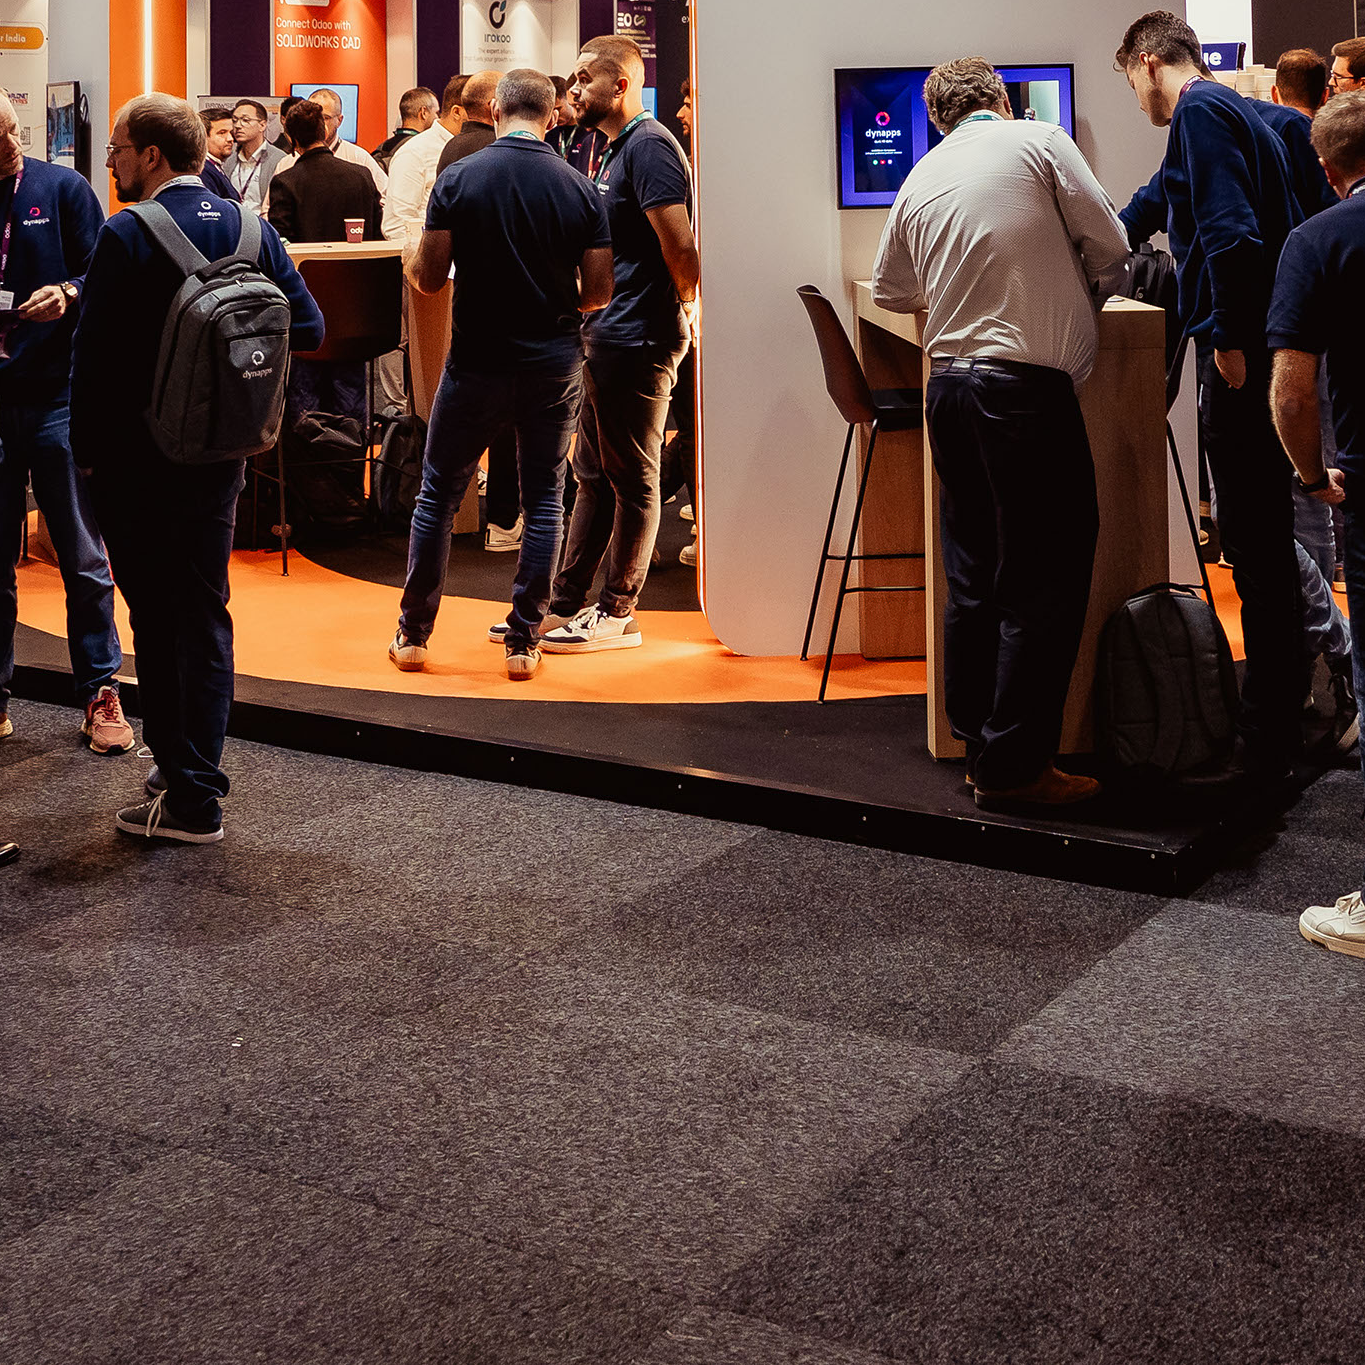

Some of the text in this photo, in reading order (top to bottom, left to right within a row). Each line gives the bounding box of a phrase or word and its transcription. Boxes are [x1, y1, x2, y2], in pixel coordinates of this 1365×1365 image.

[275, 16, 352, 31] Connect Odoo with
[5, 32, 26, 43] India
[275, 33, 362, 50] SOLIDWORKS CAD
[865, 128, 902, 139] dynapps
[22, 217, 51, 227] dynapps
[242, 365, 274, 380] dynapps
